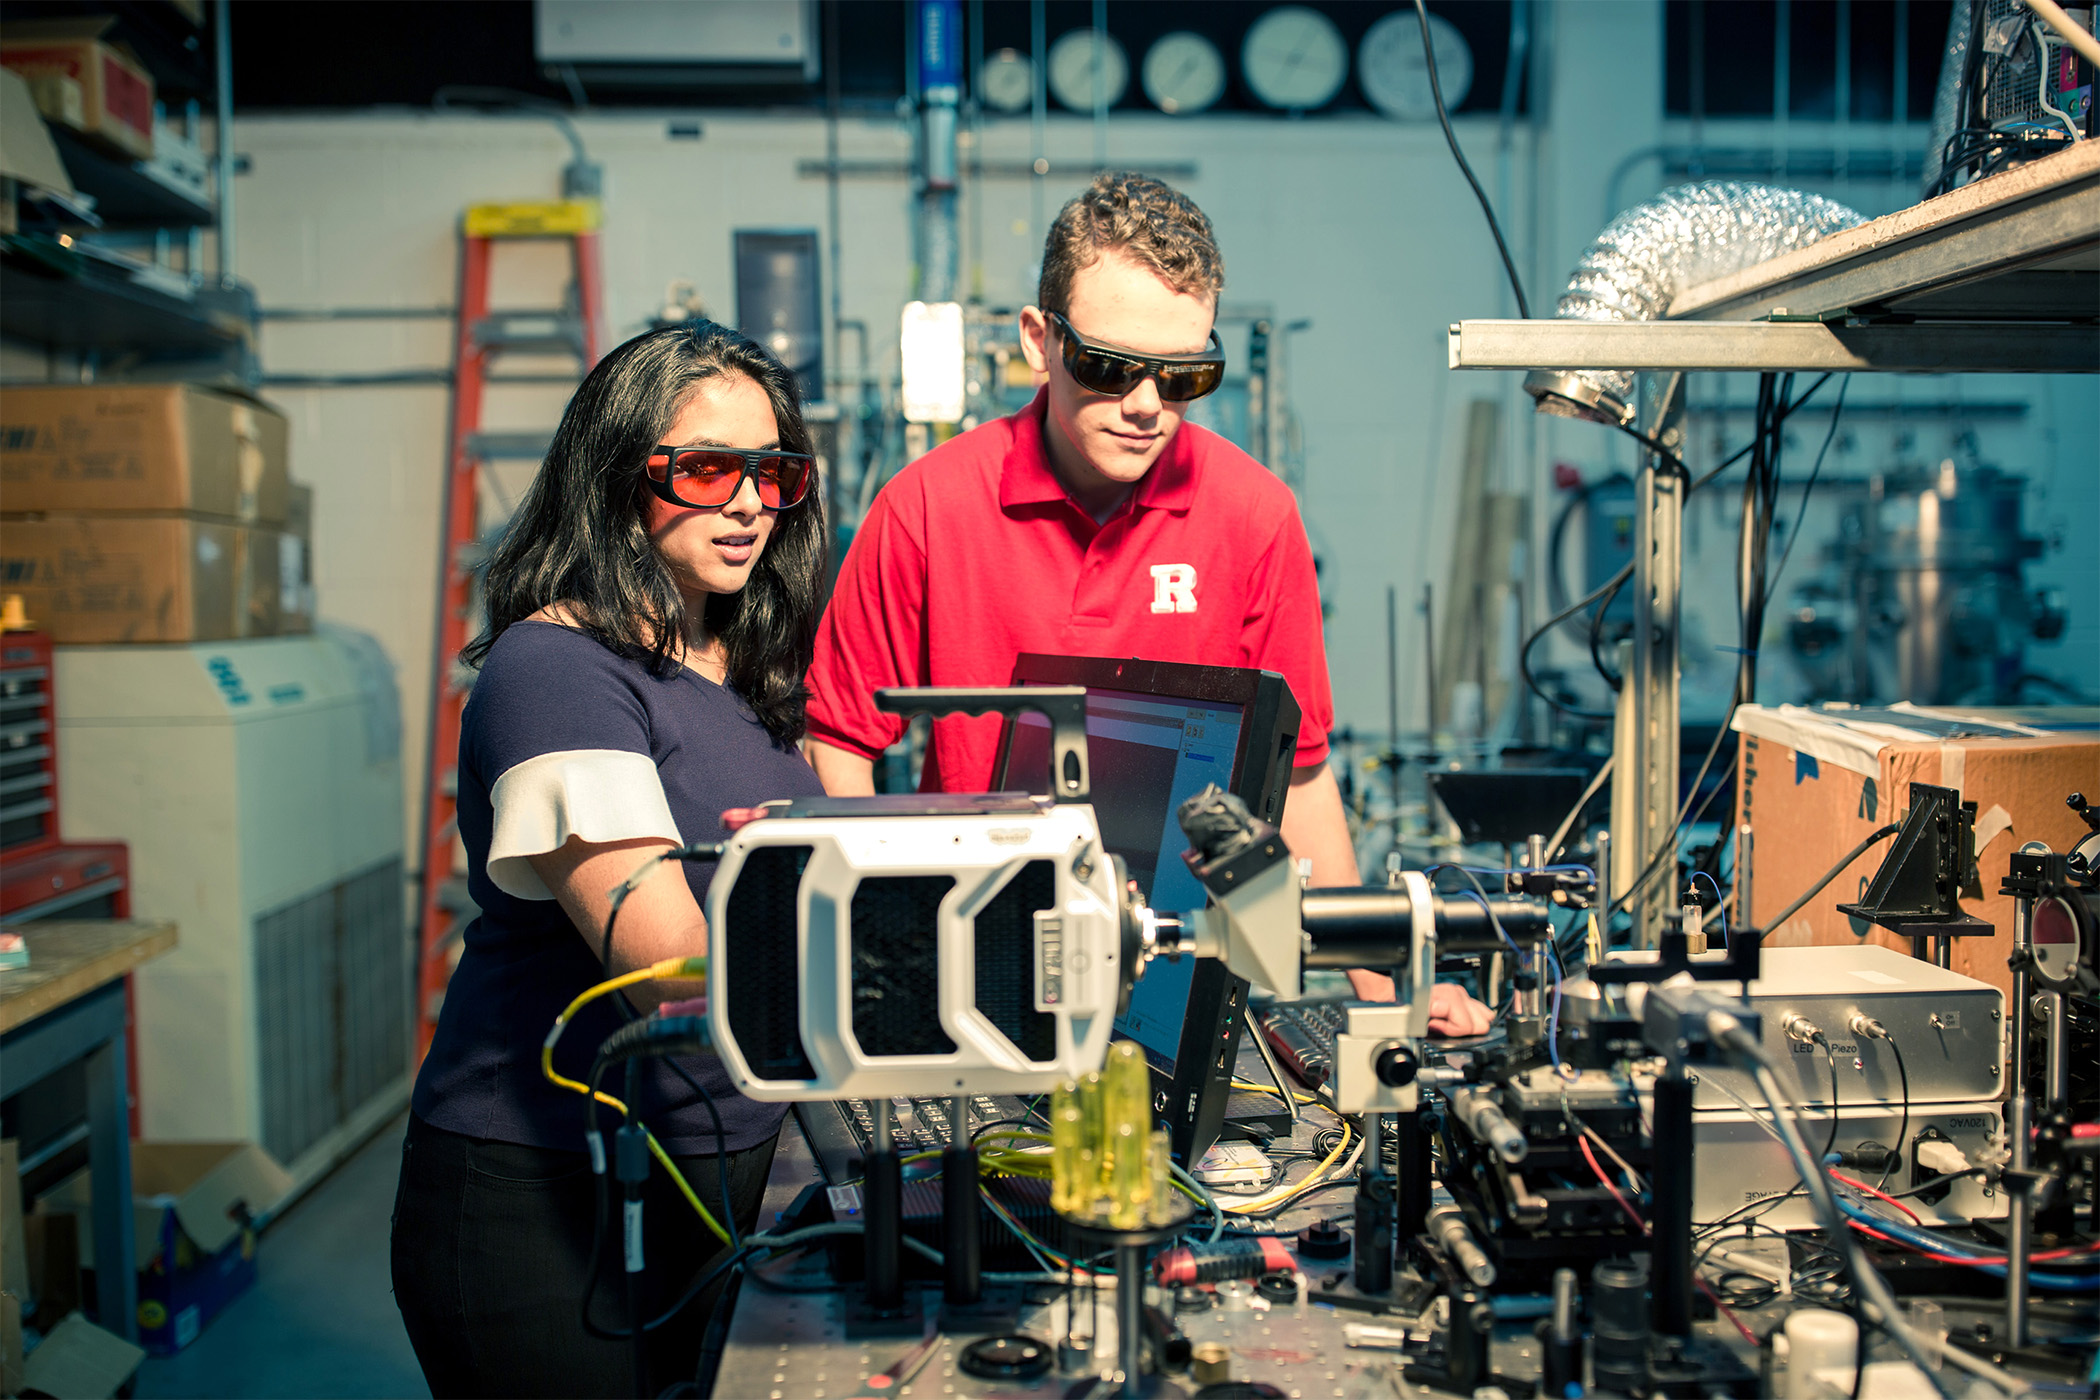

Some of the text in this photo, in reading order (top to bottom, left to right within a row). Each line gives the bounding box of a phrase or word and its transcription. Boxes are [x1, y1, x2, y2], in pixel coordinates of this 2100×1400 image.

[1150, 563, 1198, 614] R
[1743, 734, 1759, 824] isher
[1793, 1044, 1857, 1054] LED Piezo
[1949, 1118, 1986, 1128] 120VAC
